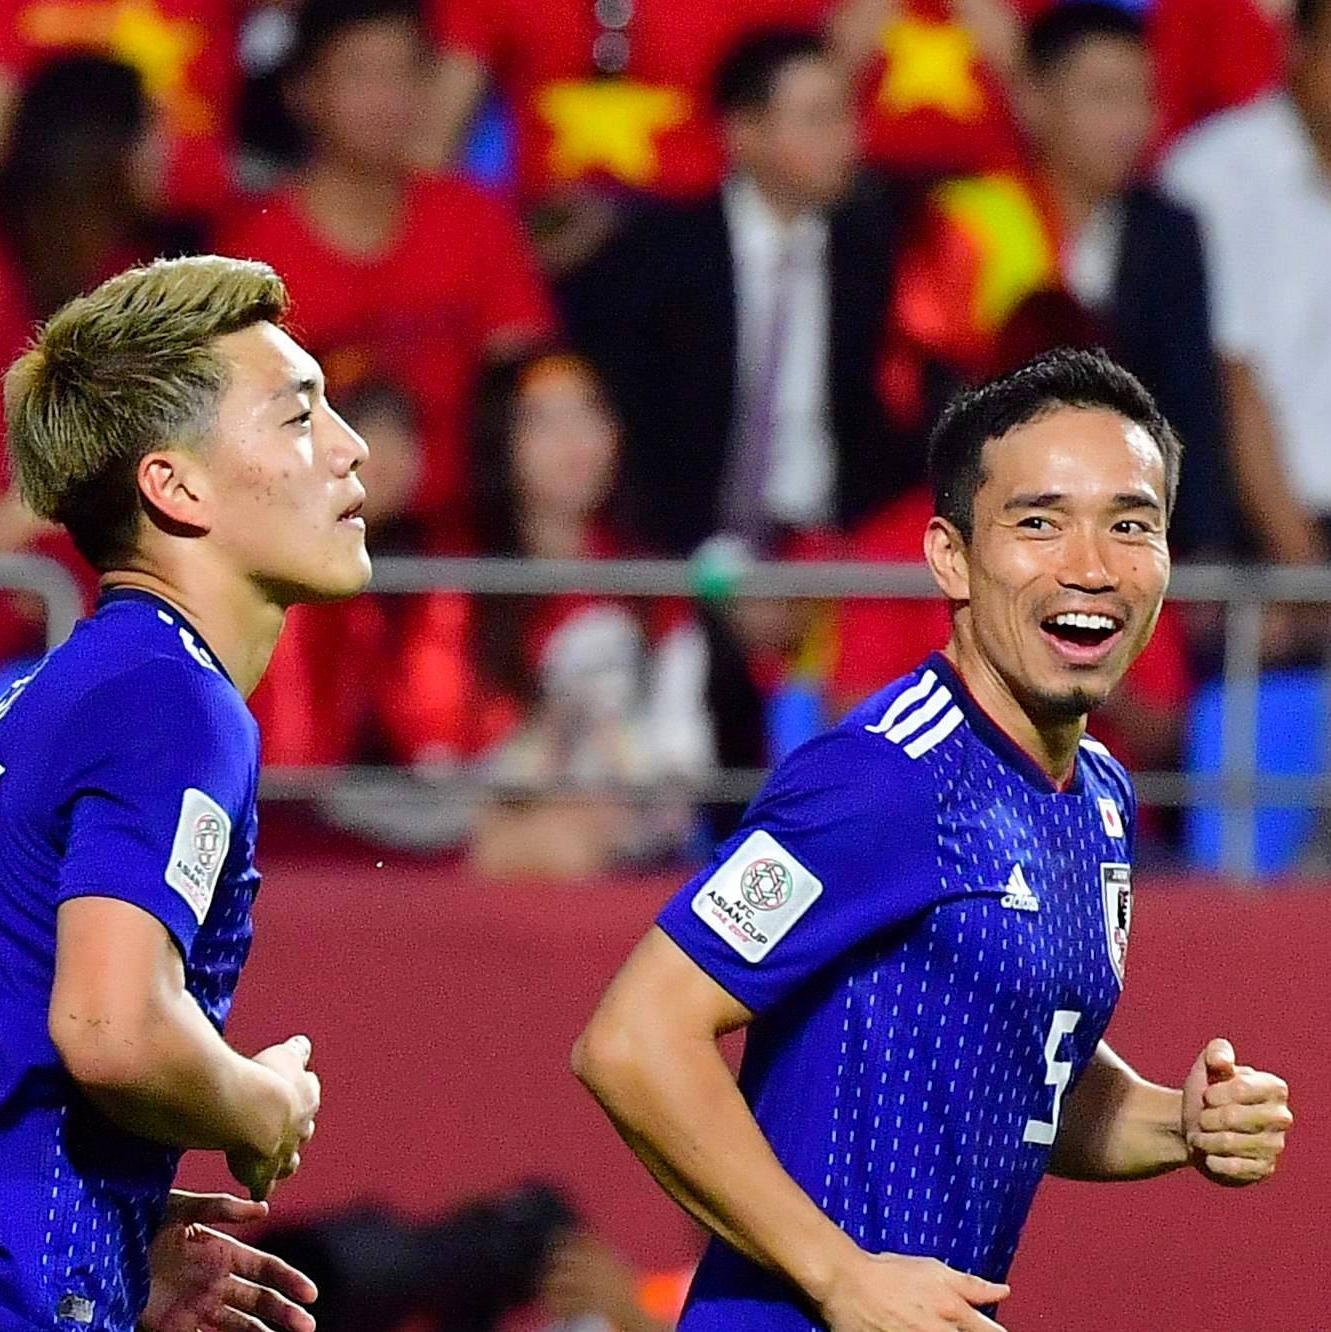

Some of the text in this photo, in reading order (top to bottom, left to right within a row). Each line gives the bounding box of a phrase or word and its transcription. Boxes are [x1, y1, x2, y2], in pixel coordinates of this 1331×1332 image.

[707, 890, 769, 945] ASIAN CUP
[733, 900, 756, 920] AFC
[1023, 1010, 1081, 1145] 5
